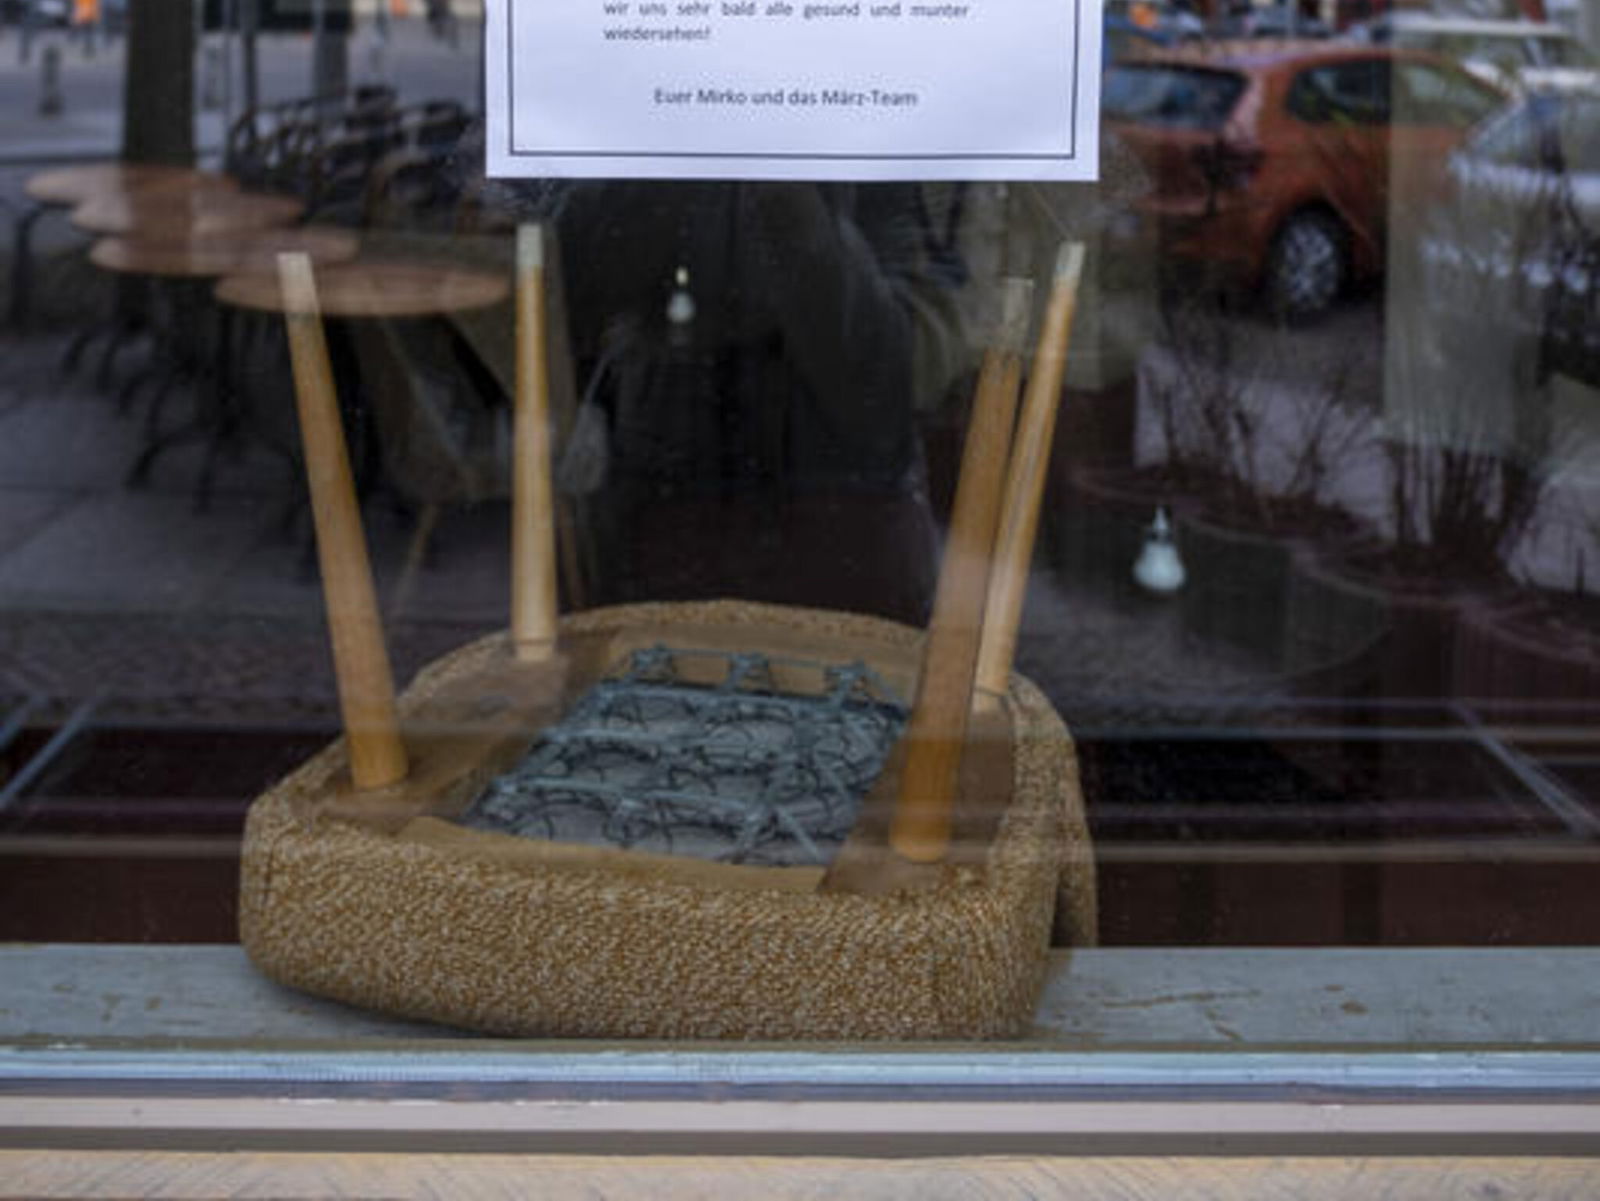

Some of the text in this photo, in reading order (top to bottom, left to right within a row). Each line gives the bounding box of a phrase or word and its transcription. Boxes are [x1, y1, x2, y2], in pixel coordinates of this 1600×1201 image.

[603, 0, 969, 20] wir uns sehr bald alle gesund und munter
[603, 25, 710, 42] wiedersehen!
[653, 87, 919, 107] Euer Mirko und das März-Team
